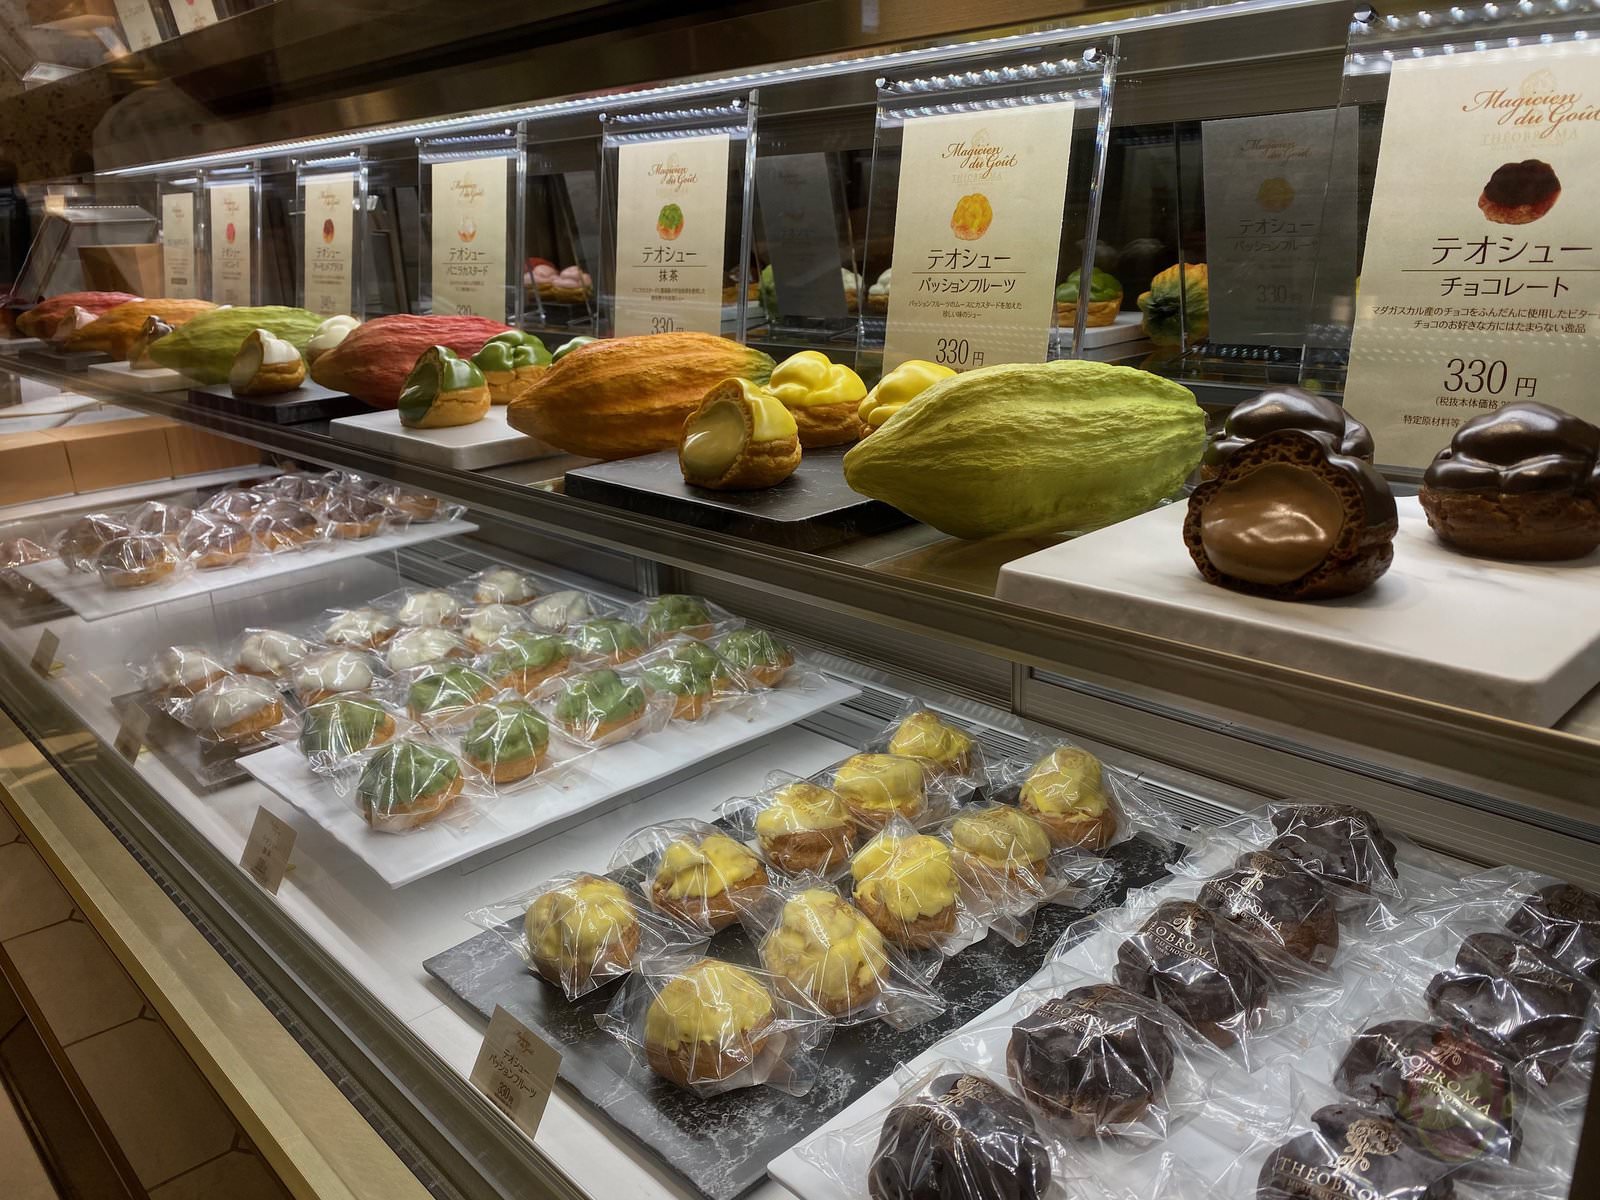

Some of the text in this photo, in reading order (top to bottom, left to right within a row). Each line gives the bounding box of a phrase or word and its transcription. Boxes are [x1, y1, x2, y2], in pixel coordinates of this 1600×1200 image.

[1461, 87, 1583, 126] Magicien
[1513, 106, 1545, 126] du
[941, 142, 1003, 169] Magicien
[982, 153, 1018, 179] Goût
[1239, 218, 1316, 234] テオシュー
[449, 248, 486, 261] テオシュー
[642, 246, 697, 263] テオシュー
[928, 248, 1011, 270] テオシュー
[1432, 236, 1593, 265] テオシュー
[658, 269, 680, 282] 抹茶
[918, 277, 1016, 294] パッションフルーツ
[1440, 277, 1569, 298] チョコレート
[1371, 304, 1600, 319] マダガスカル産のチョコをふんだんに使用したビター
[935, 338, 985, 367] 330 円
[1443, 358, 1538, 398] 330 円
